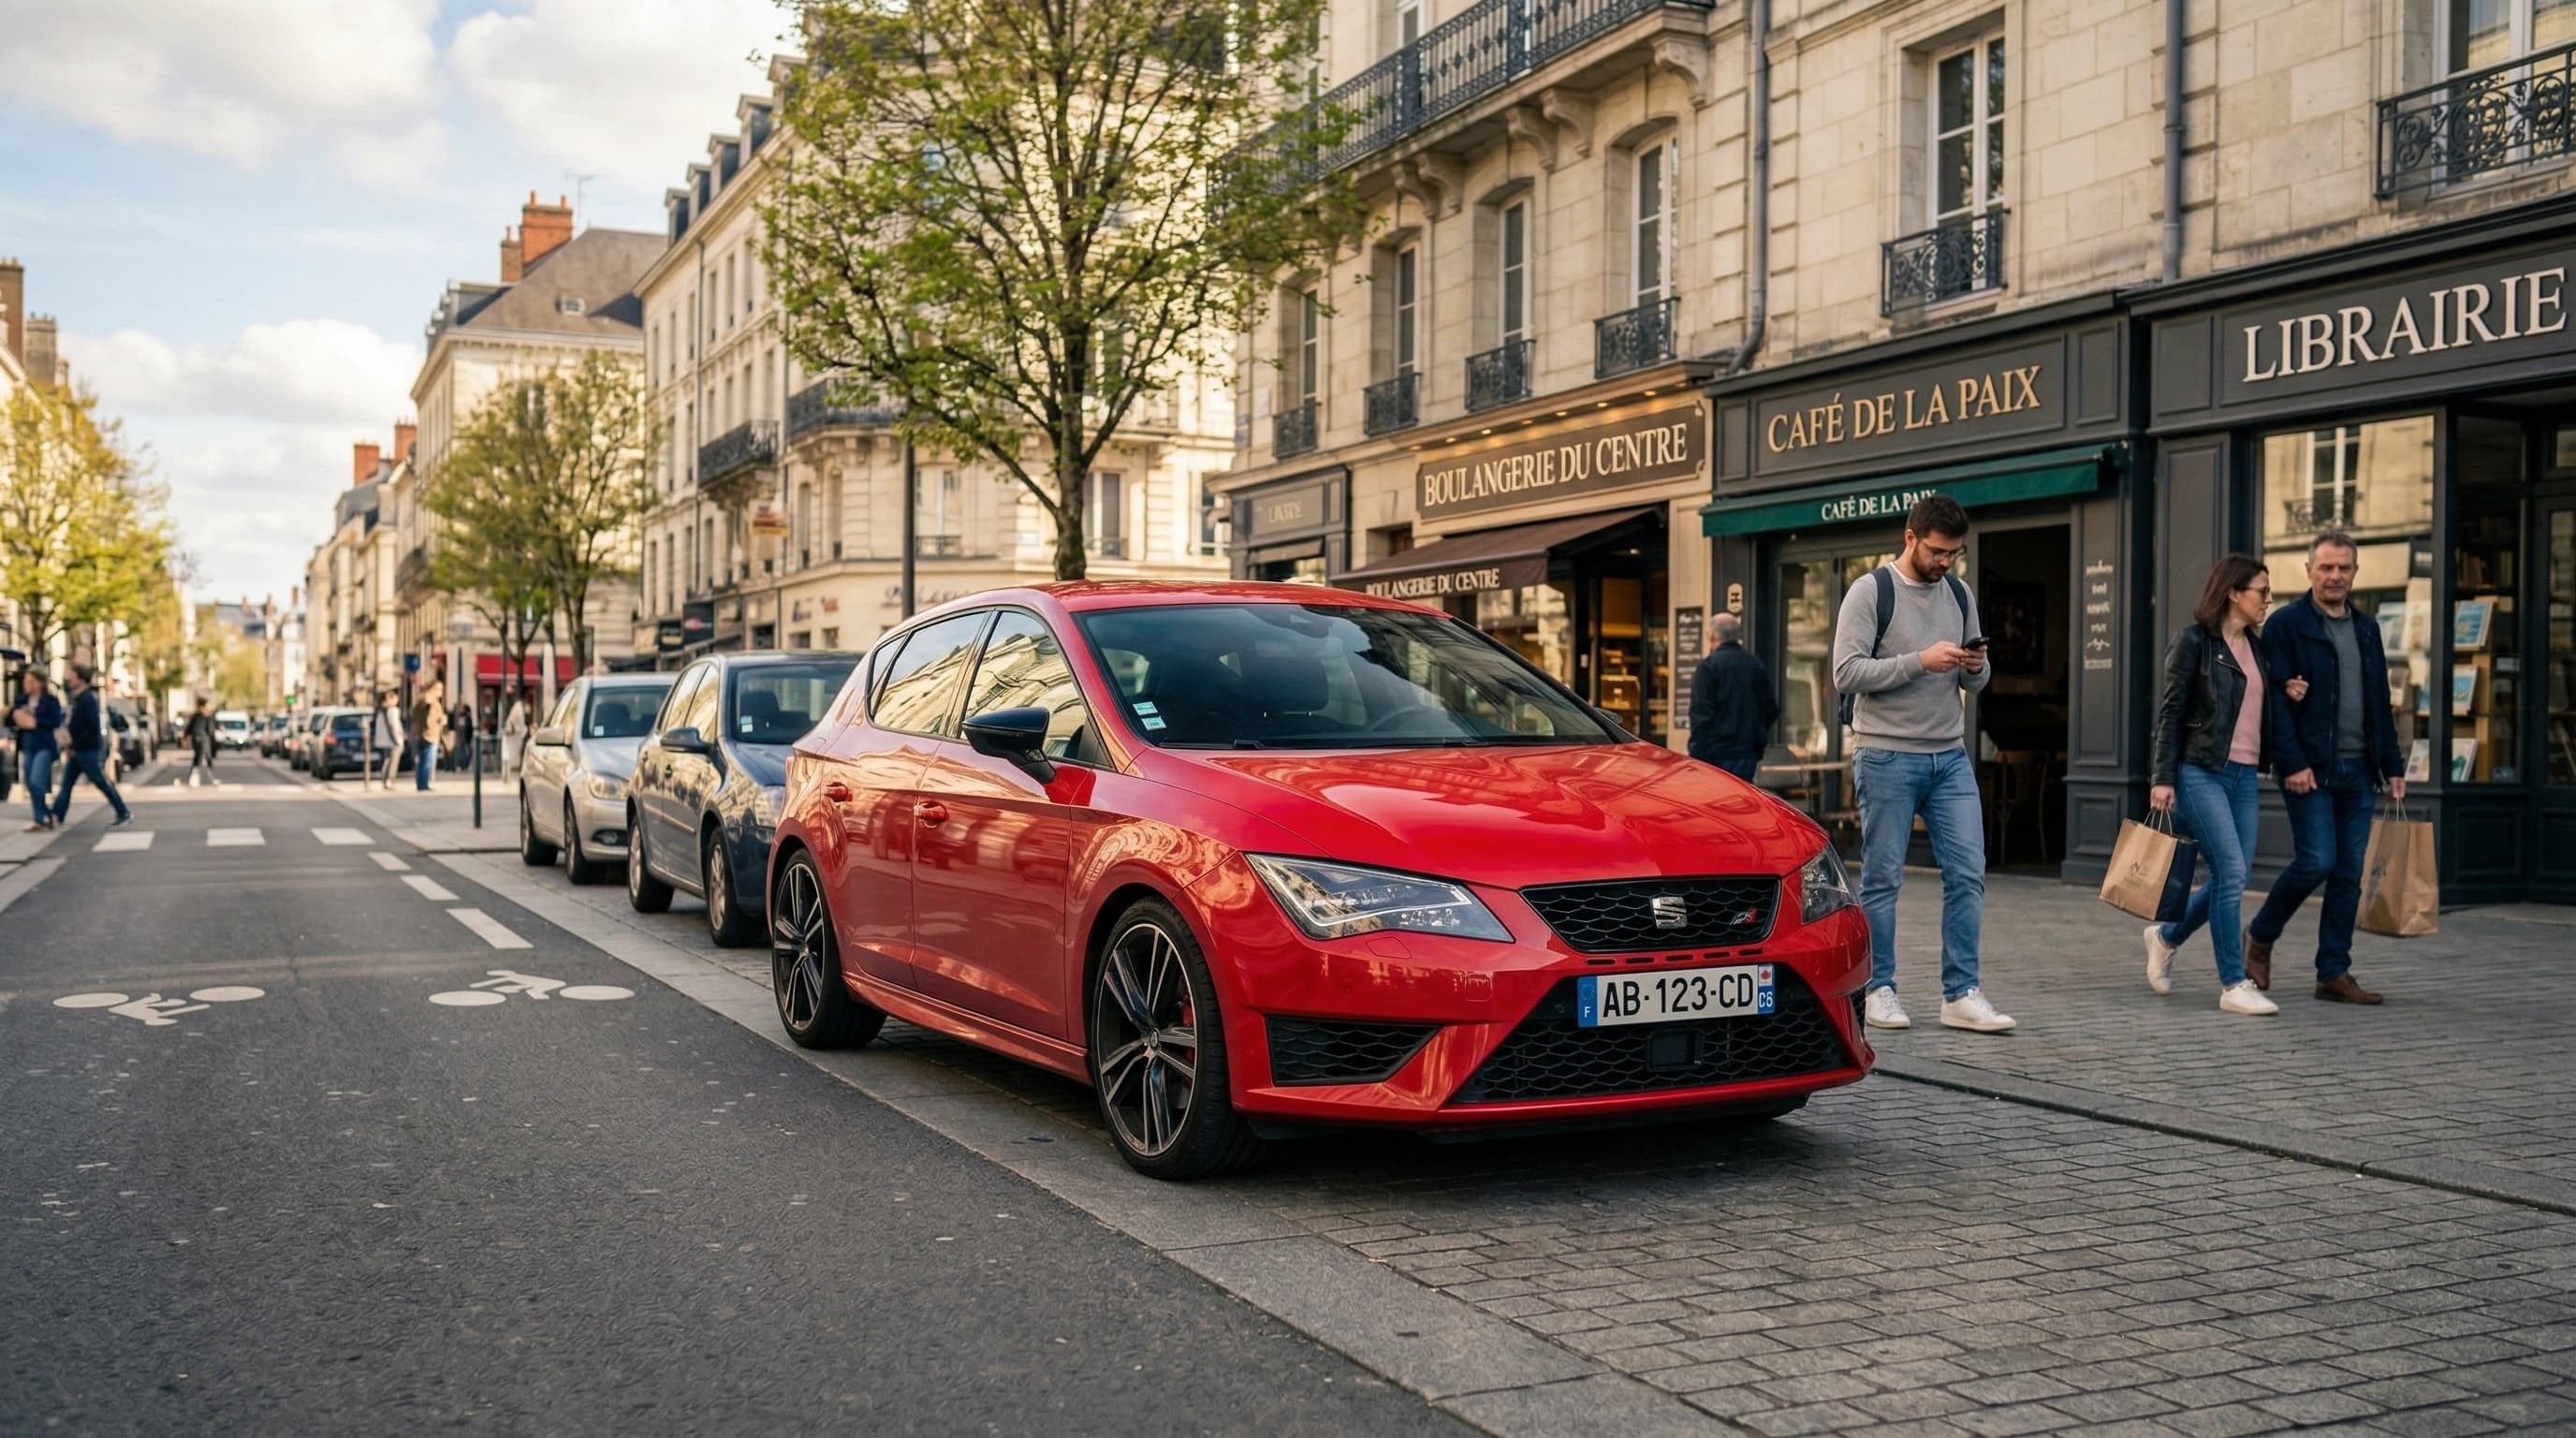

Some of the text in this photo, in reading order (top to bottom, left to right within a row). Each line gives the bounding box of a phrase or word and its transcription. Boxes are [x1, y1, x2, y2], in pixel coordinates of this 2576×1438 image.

[2242, 267, 2567, 383] LIBRAIRIE
[1767, 364, 2042, 453] CAFÉ DE LA PAIX
[1424, 422, 1688, 506] BOULANGERIE DU CENTRE
[1821, 495, 1857, 521] CAFÉ
[1859, 496, 1878, 516] DE
[1881, 494, 1901, 513] LA
[1438, 573, 1455, 594] DU
[1456, 568, 1500, 592] CENTRE
[1584, 1005, 1591, 1018] F
[1758, 990, 1773, 1008] C6
